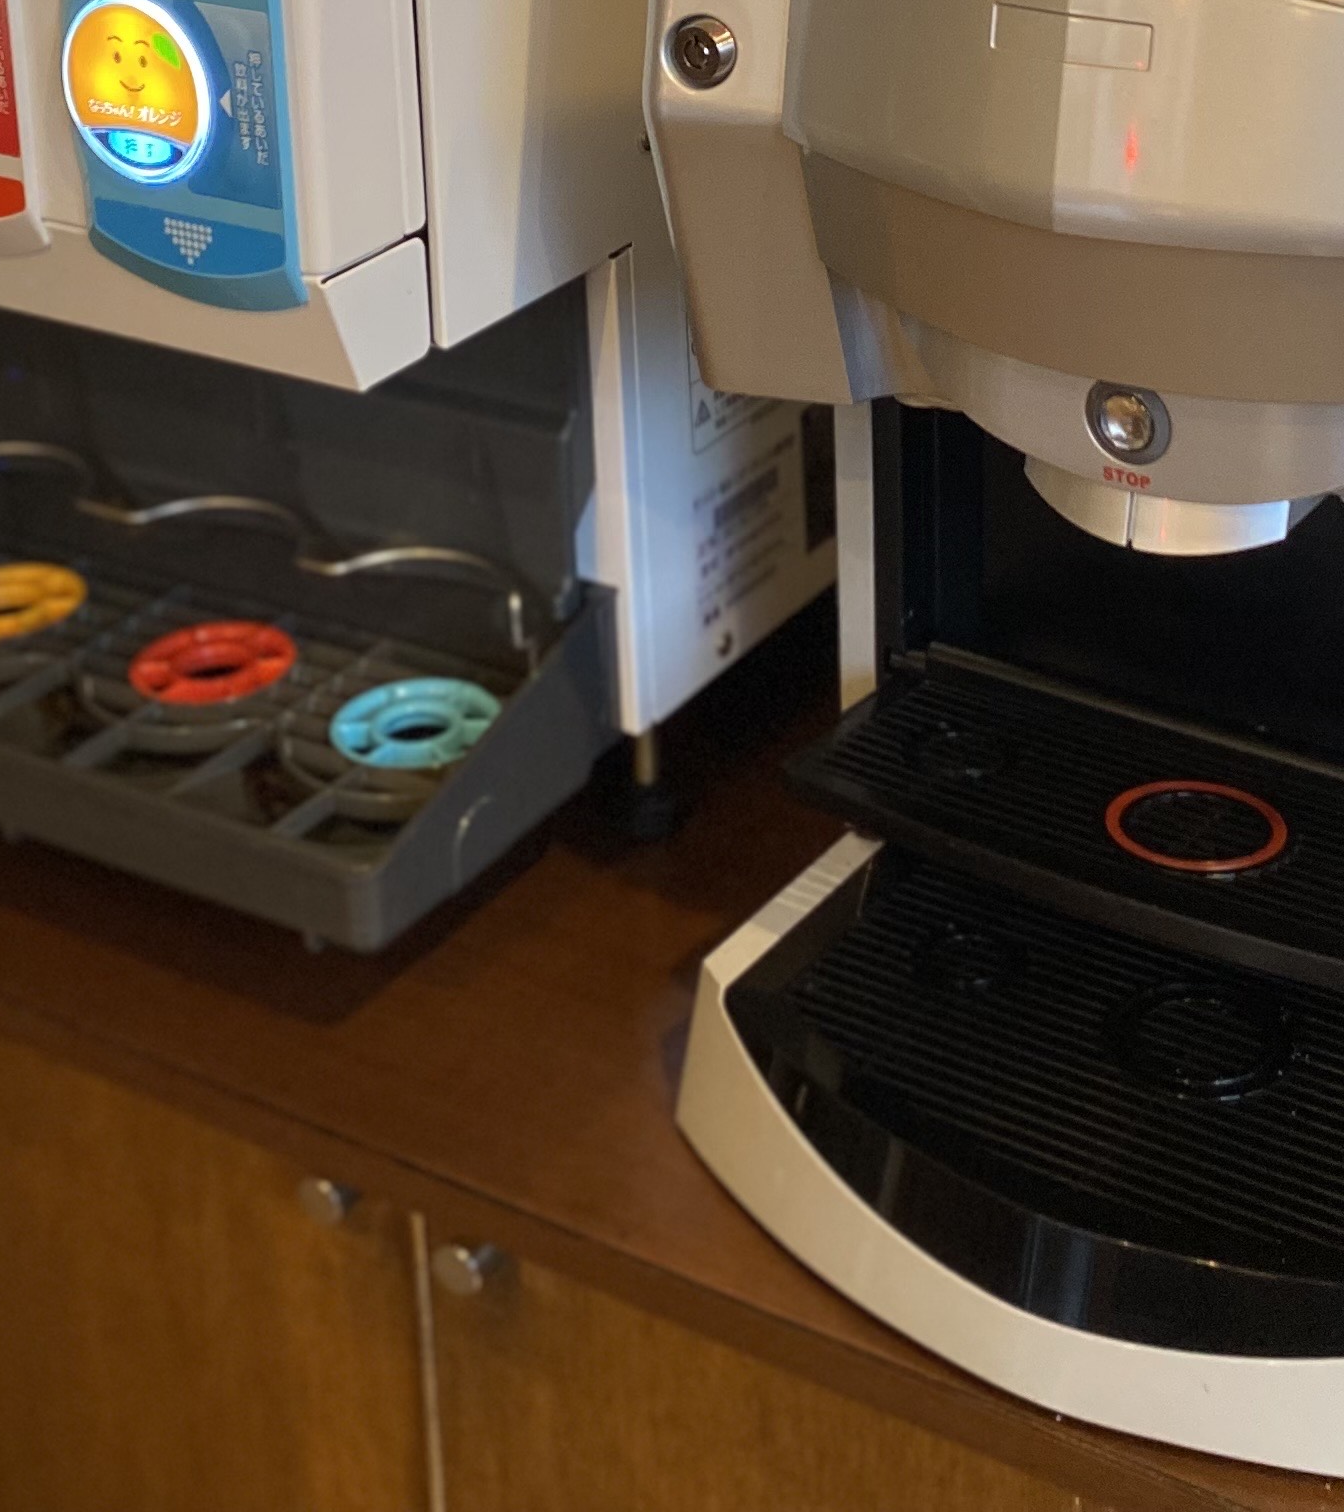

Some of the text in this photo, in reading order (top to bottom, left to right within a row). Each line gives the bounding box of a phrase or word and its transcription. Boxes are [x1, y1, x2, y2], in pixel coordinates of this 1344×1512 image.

[137, 105, 183, 127] オレンジ
[1103, 465, 1152, 489] STOP
